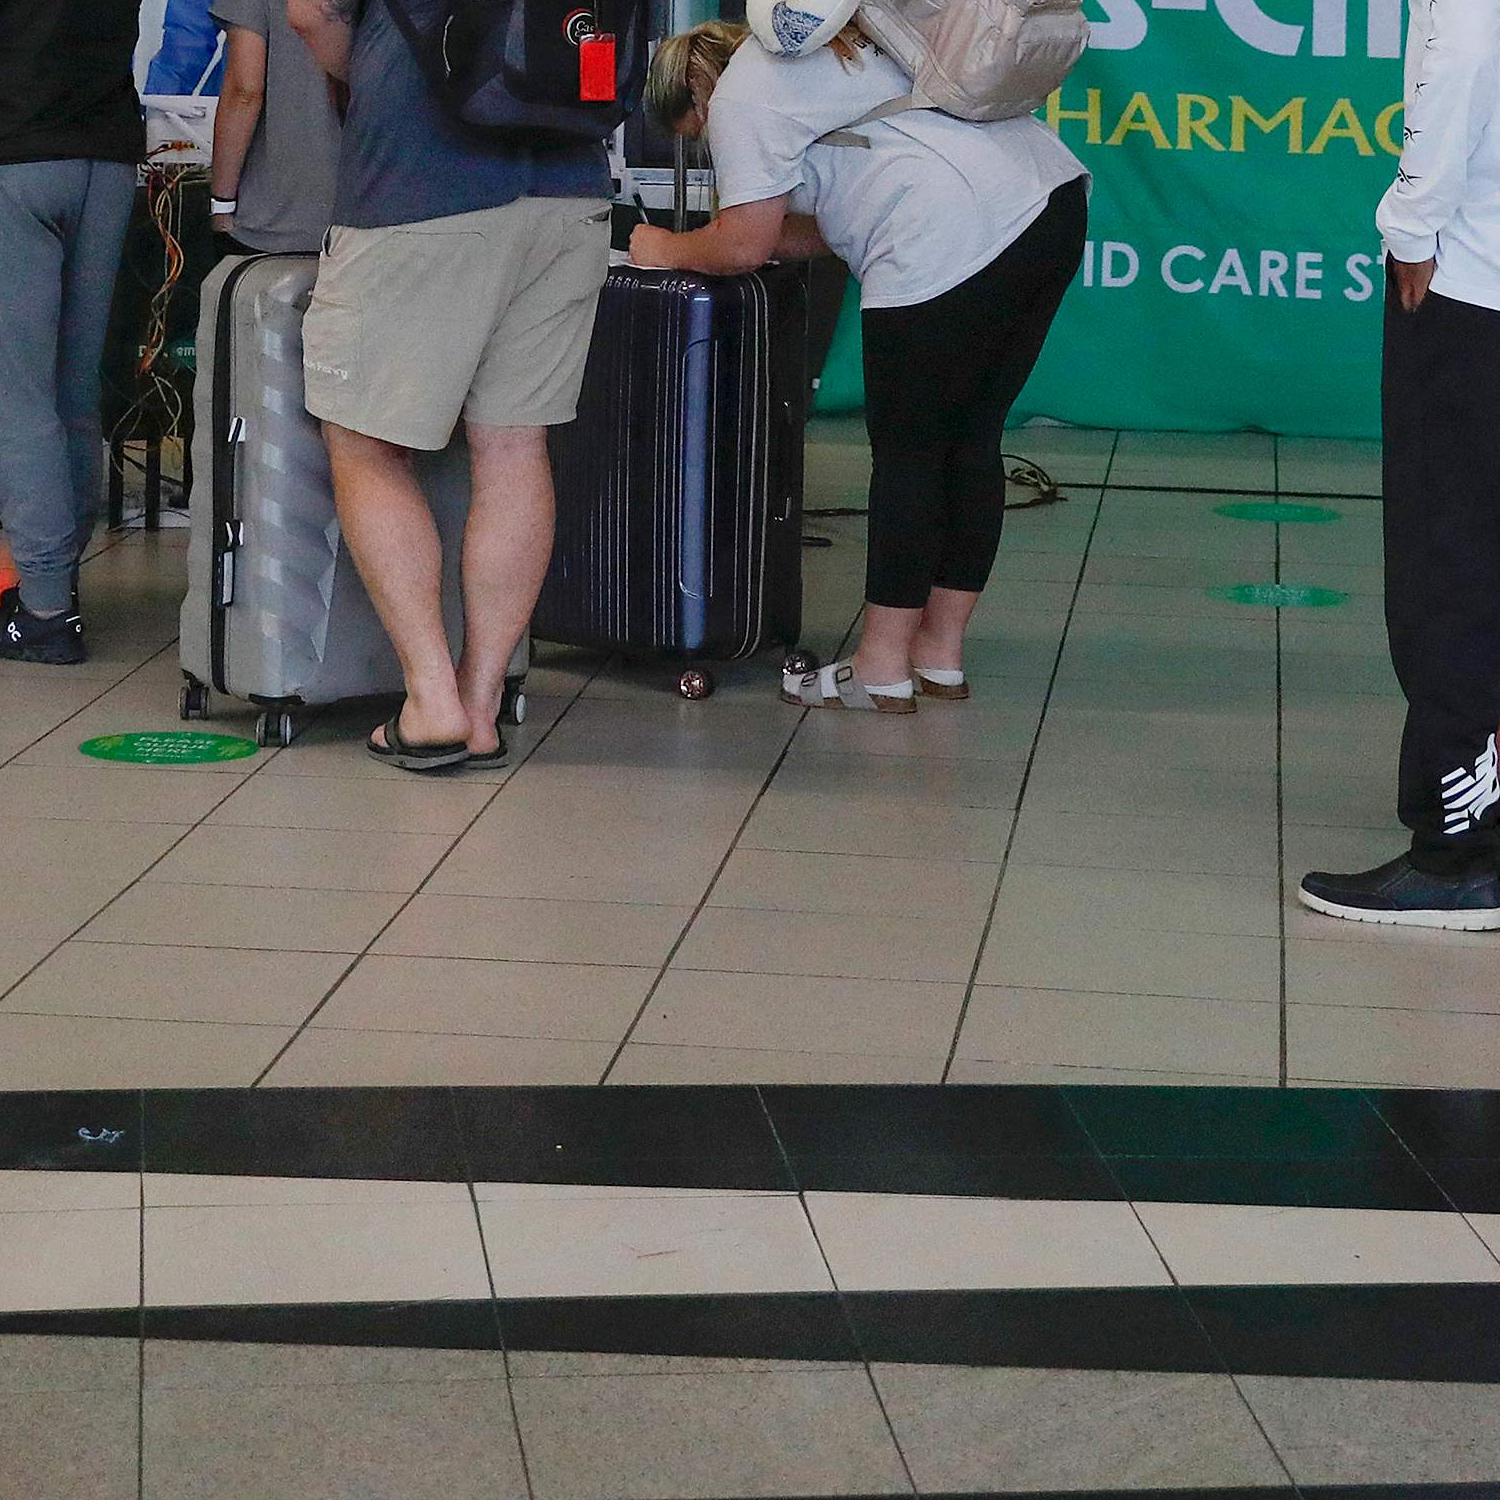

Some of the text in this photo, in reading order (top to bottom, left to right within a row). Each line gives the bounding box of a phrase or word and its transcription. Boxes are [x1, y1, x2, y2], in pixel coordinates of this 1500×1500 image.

[1046, 86, 1405, 157] HARMAC
[1082, 240, 1386, 302] ID CARE S
